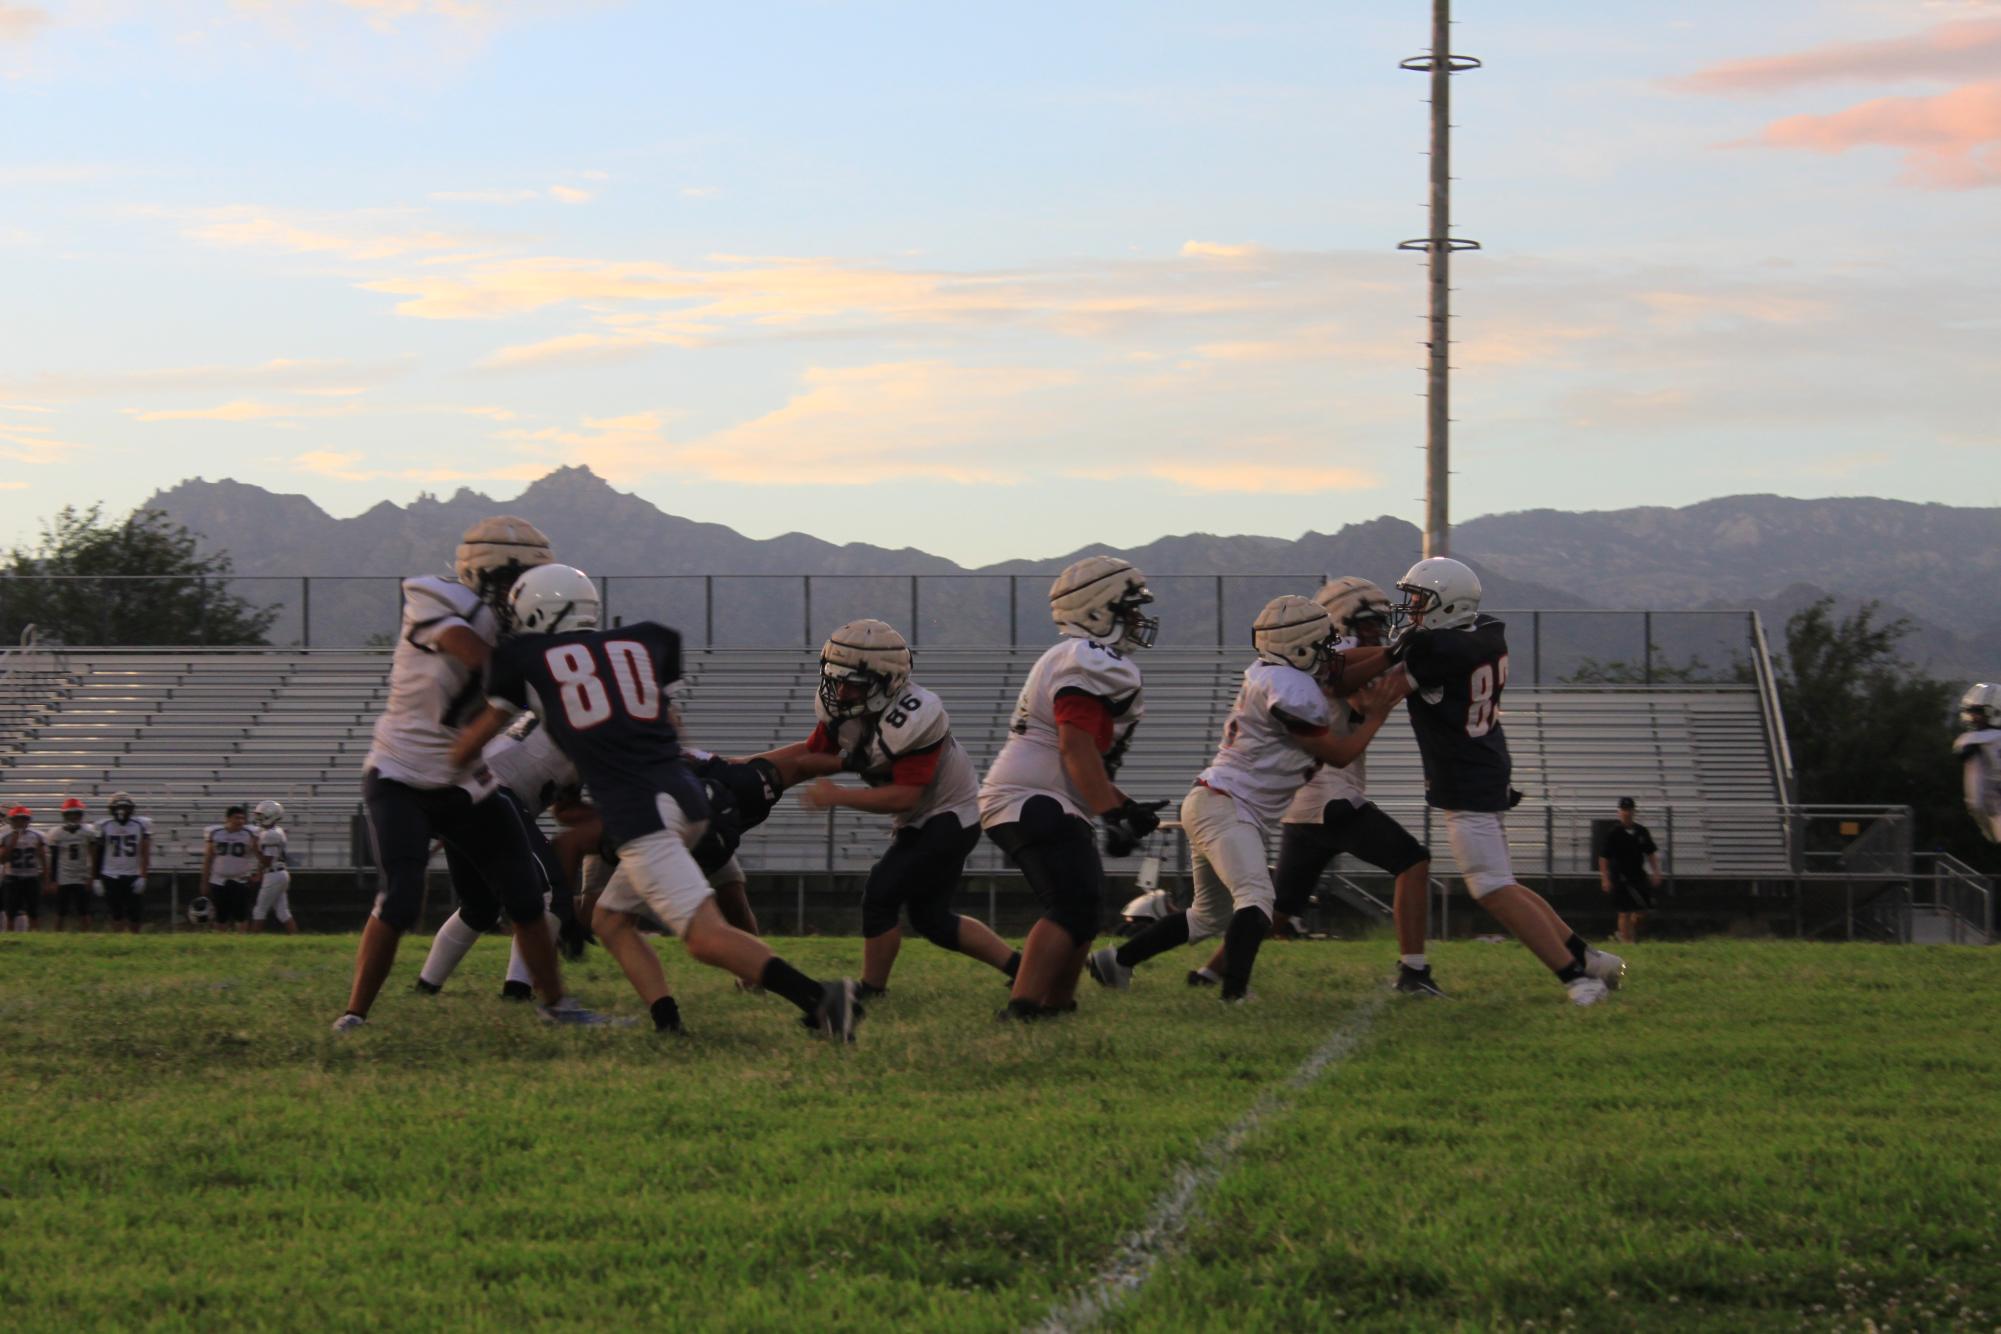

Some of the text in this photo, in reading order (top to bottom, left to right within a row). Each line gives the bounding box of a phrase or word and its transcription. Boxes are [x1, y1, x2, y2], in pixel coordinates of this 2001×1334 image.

[543, 639, 662, 731] 80
[885, 693, 921, 728] 86
[11, 848, 36, 868] 22
[110, 835, 136, 857] 75
